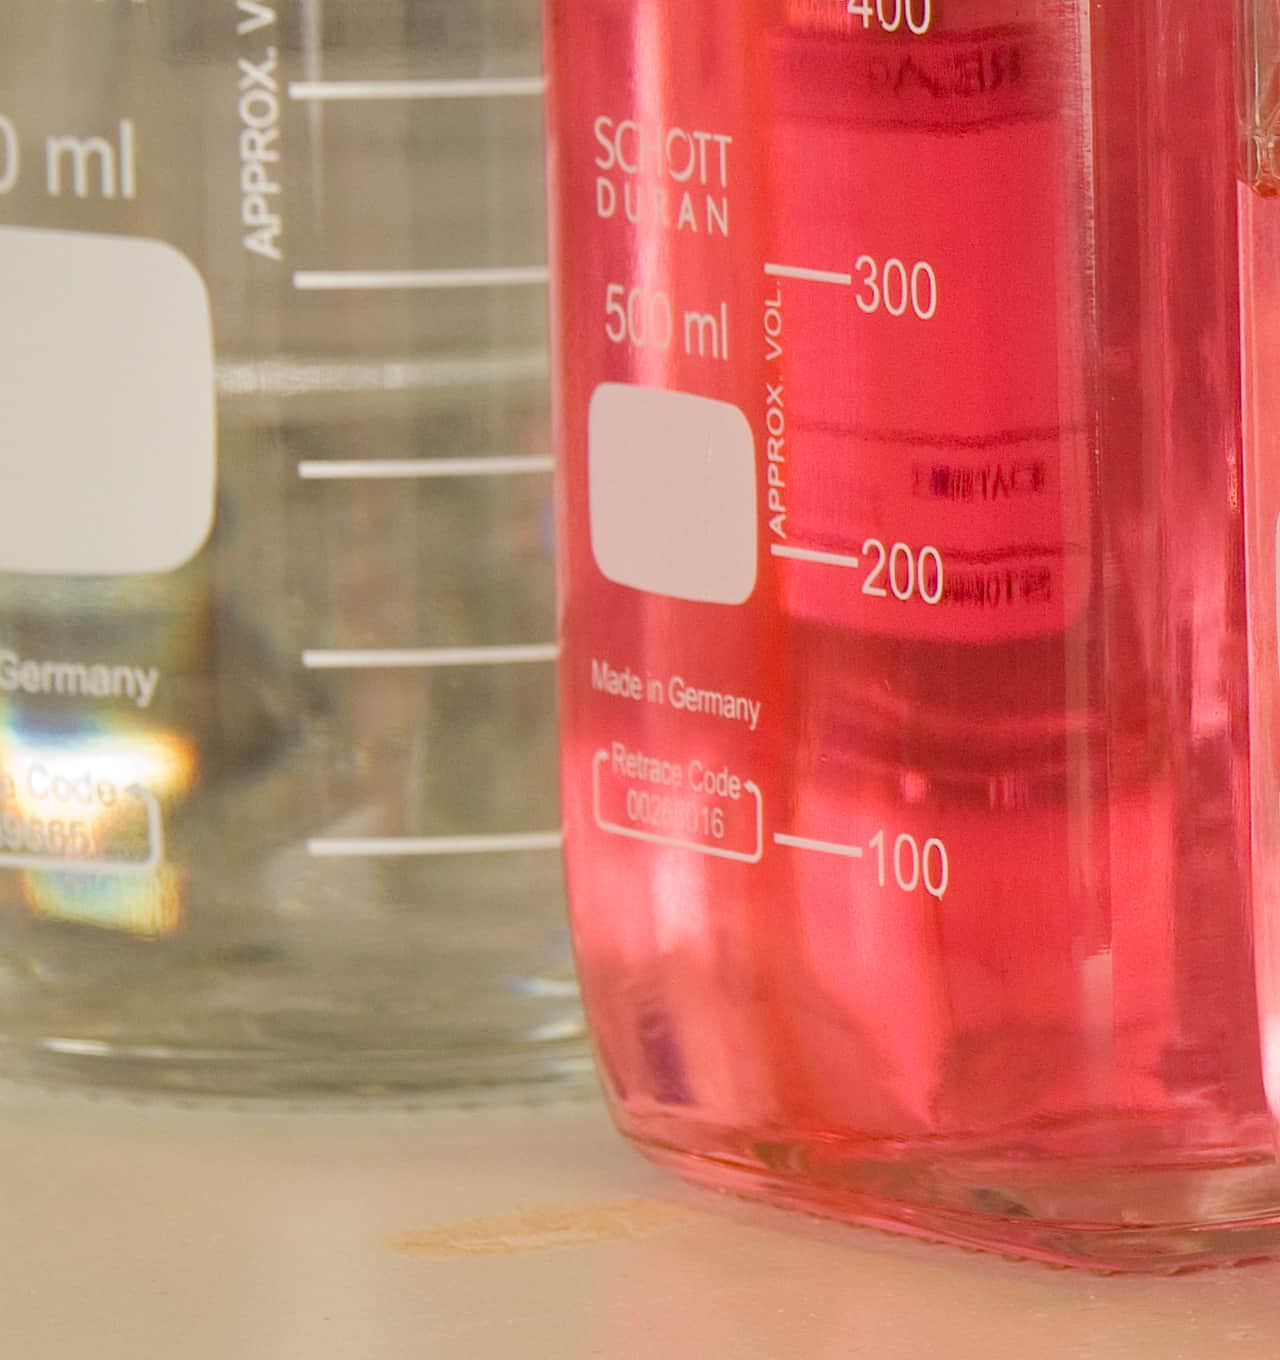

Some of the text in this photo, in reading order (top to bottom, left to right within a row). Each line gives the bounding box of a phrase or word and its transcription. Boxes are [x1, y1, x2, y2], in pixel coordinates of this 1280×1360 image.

[46, 119, 136, 199] ml
[238, 46, 283, 260] APPROX.
[593, 115, 733, 188] SCHOTT
[596, 176, 729, 238] DURAN
[605, 283, 729, 361] 500 ml
[855, 255, 937, 320] 300
[764, 280, 788, 539] APPROX. VOL.
[862, 538, 944, 604] 200
[591, 659, 761, 732] Made in Germany
[612, 741, 742, 800] Retrace Code
[868, 829, 949, 898] 100
